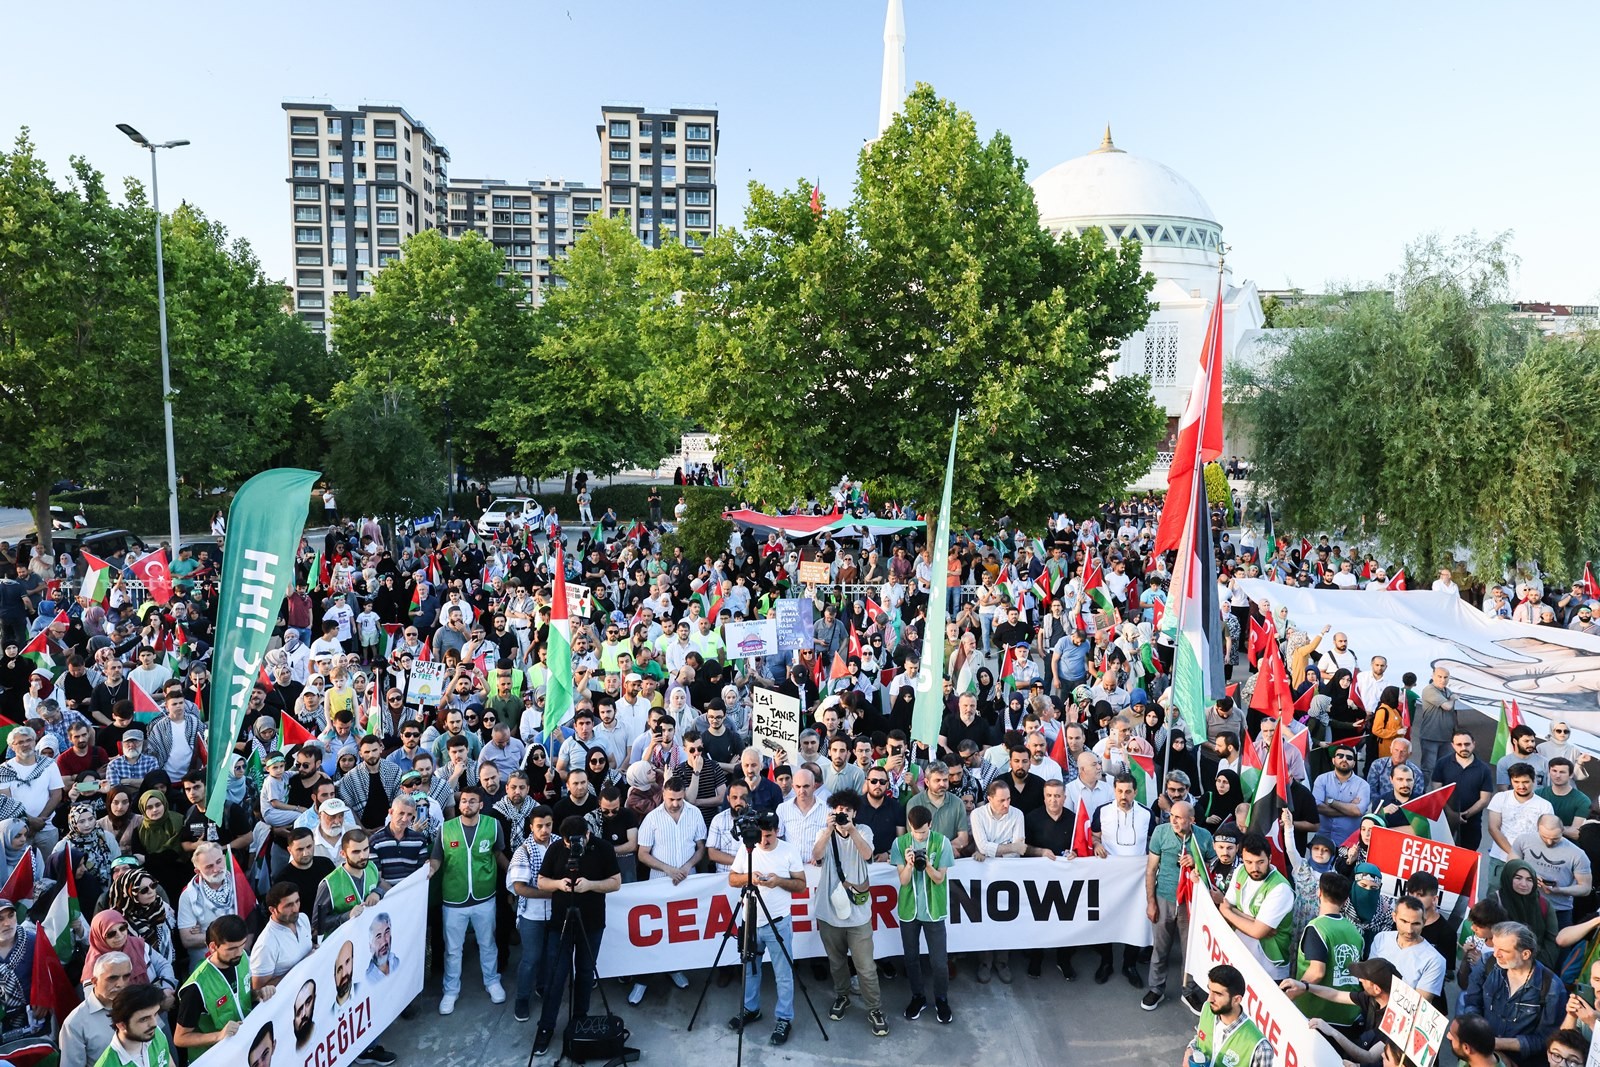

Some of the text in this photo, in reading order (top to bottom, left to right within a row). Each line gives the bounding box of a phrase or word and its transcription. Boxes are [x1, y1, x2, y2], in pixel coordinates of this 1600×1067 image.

[415, 661, 436, 670] UNTIL
[1401, 838, 1452, 866] CEASE
[949, 879, 1100, 924] NOW!
[1246, 984, 1282, 1056] THE
